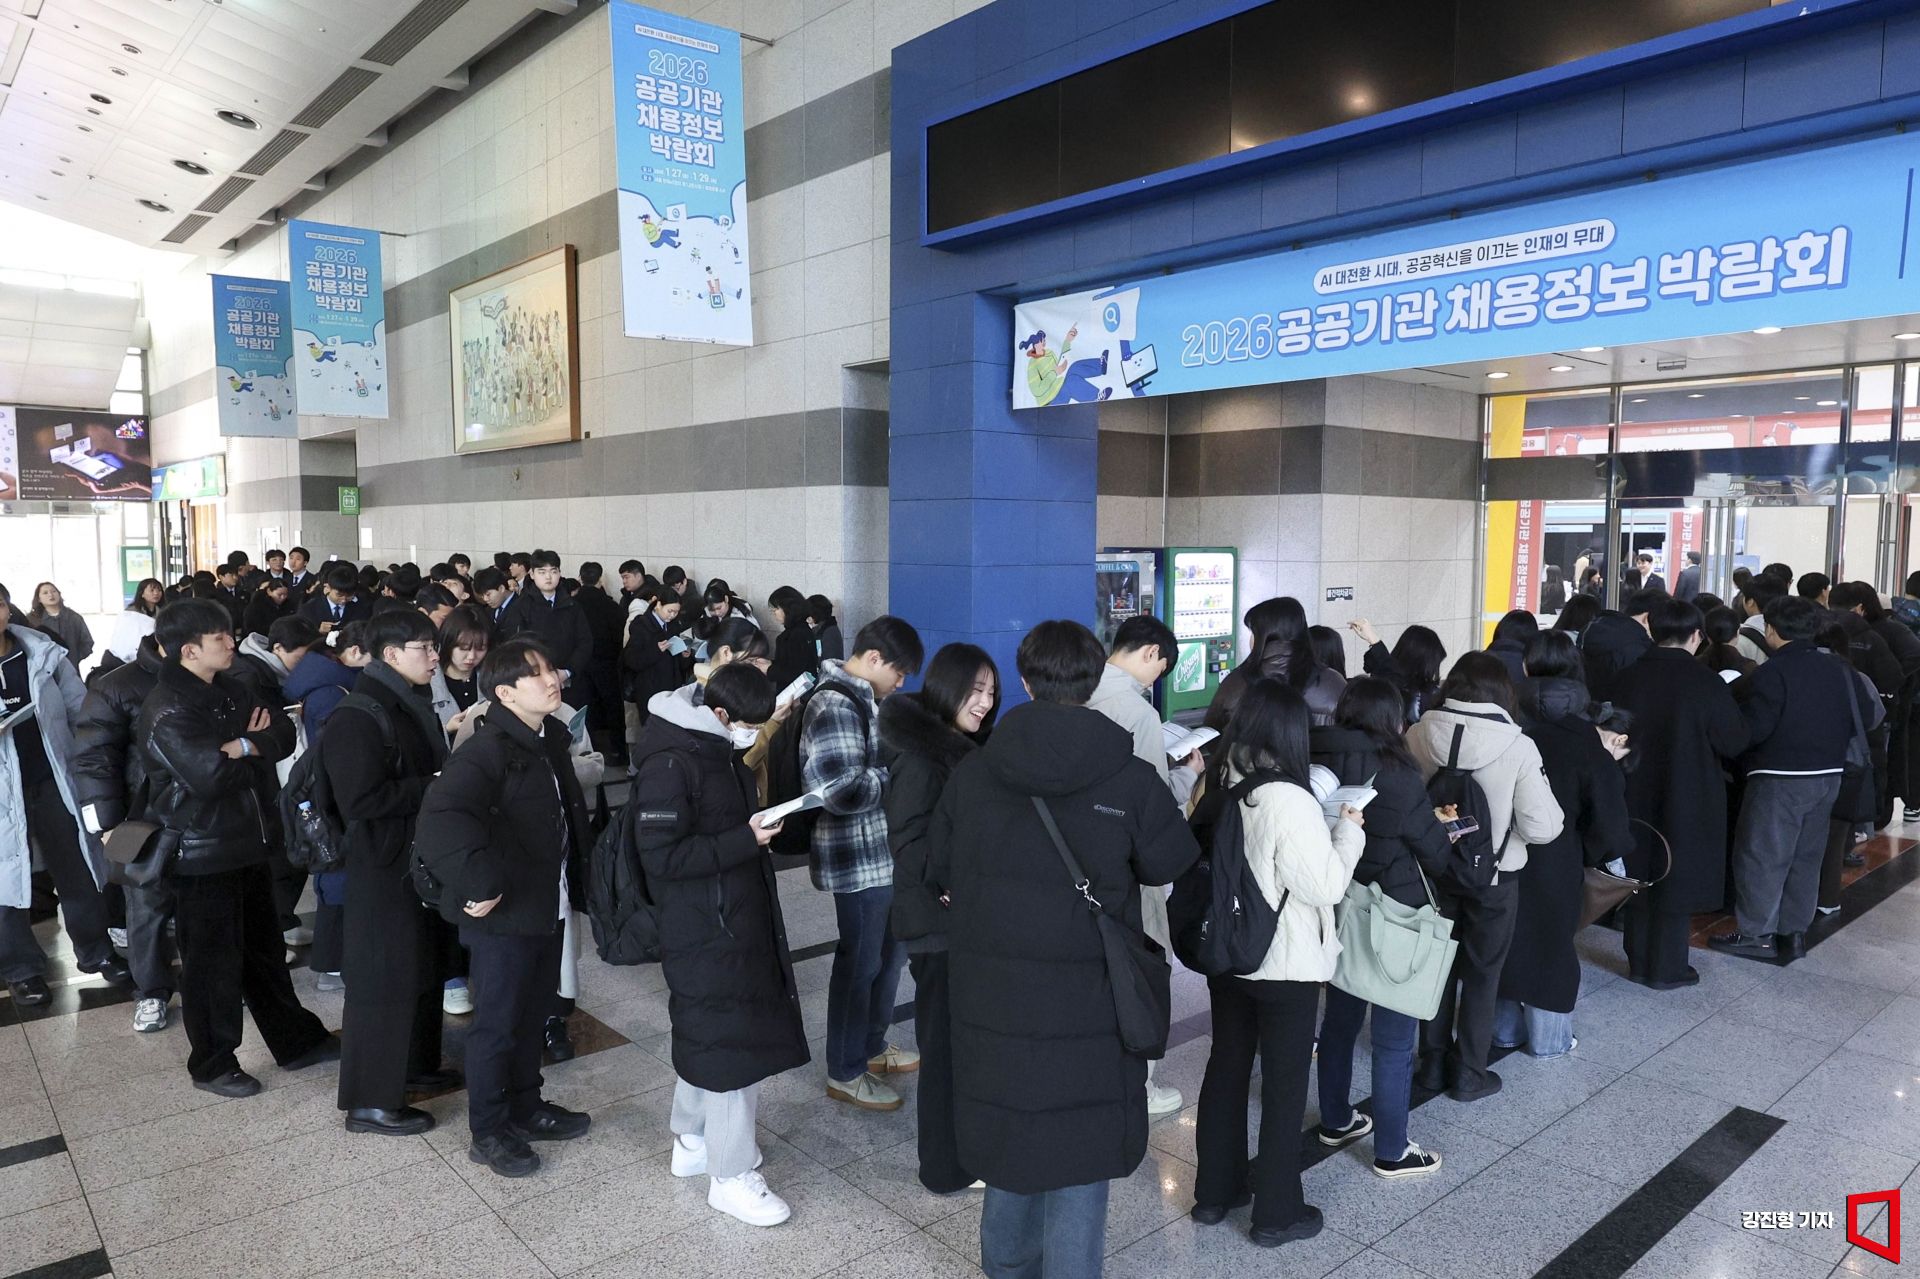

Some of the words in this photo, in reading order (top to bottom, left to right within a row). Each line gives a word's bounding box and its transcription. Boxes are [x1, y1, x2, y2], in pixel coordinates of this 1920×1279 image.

[648, 49, 709, 86] 2026
[635, 73, 723, 116] 공공기관
[636, 102, 725, 143] 채용정보
[649, 132, 715, 168] 박람회
[314, 246, 358, 264] 2026
[1320, 274, 1333, 288] AI
[1334, 265, 1371, 286] 대전환
[1375, 261, 1403, 279] 시대,
[1406, 248, 1473, 274] 공공혁신을
[1477, 242, 1519, 262] 이끄는
[1524, 232, 1568, 254] 인재의
[1573, 226, 1605, 245] 무대
[305, 261, 368, 282] 공공기관
[306, 279, 369, 298] 채용정보
[1181, 314, 1273, 367] 2026
[1277, 288, 1439, 355] 공공기관
[1444, 257, 1649, 335] 채용정보
[1658, 225, 1853, 305] 박람회
[234, 295, 271, 310] 2026
[314, 296, 362, 313] 박람회
[226, 308, 280, 325] 공공기관
[227, 322, 281, 338] 채용정보
[234, 336, 275, 351] 박람회
